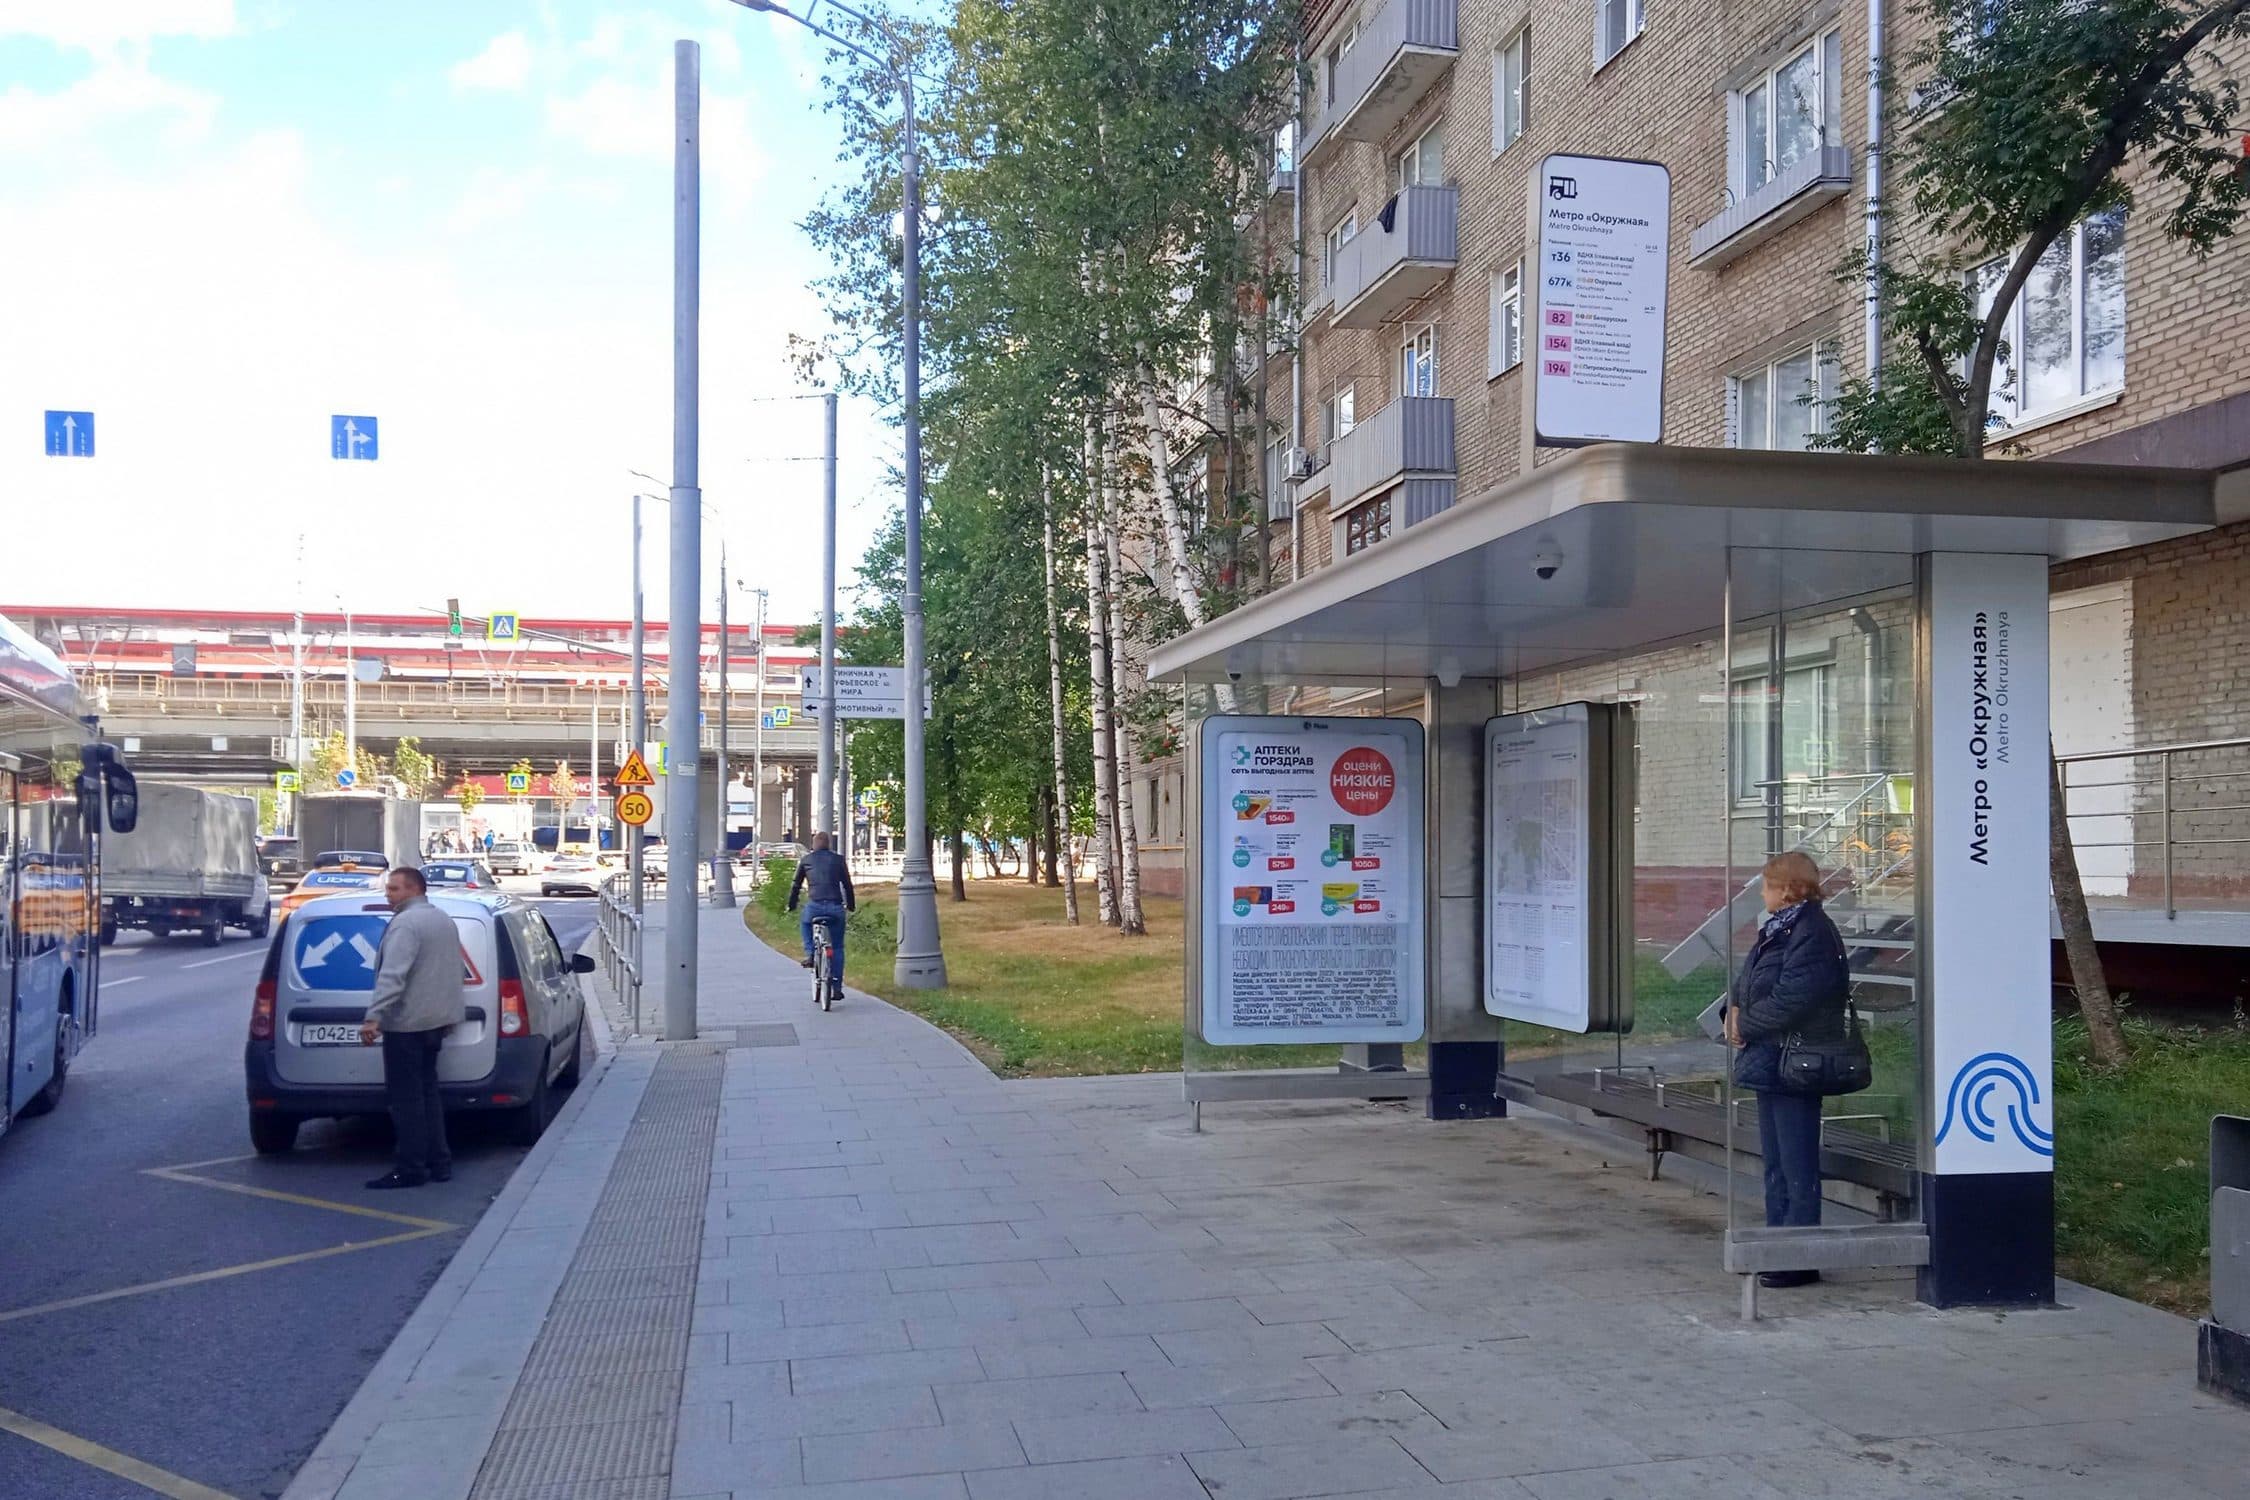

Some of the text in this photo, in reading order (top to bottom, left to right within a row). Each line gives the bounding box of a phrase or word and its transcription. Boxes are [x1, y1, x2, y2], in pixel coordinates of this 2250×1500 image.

[1549, 209, 1649, 227] Метро «Окружная»
[1548, 222, 1613, 235] Metro Okruzhnaya
[1551, 252, 1571, 263] т36
[1548, 276, 1572, 288] 677к
[1551, 313, 1566, 324] 82
[1549, 338, 1567, 349] 154
[1548, 363, 1566, 374] 194
[1996, 611, 2010, 764] Metro Okruzhnaya
[1969, 611, 1992, 865] Метро «Окружная»
[1254, 745, 1301, 755] АПТЕКИ
[1254, 756, 1314, 767] ГОРЗДРАВ
[1343, 761, 1381, 772] оцени
[1332, 774, 1392, 787] НИЗКИЕ
[1346, 790, 1379, 801] цены
[625, 802, 645, 816] 50
[338, 854, 362, 863] Uber
[317, 876, 363, 884] Uber
[309, 1026, 361, 1041] Т042Е
